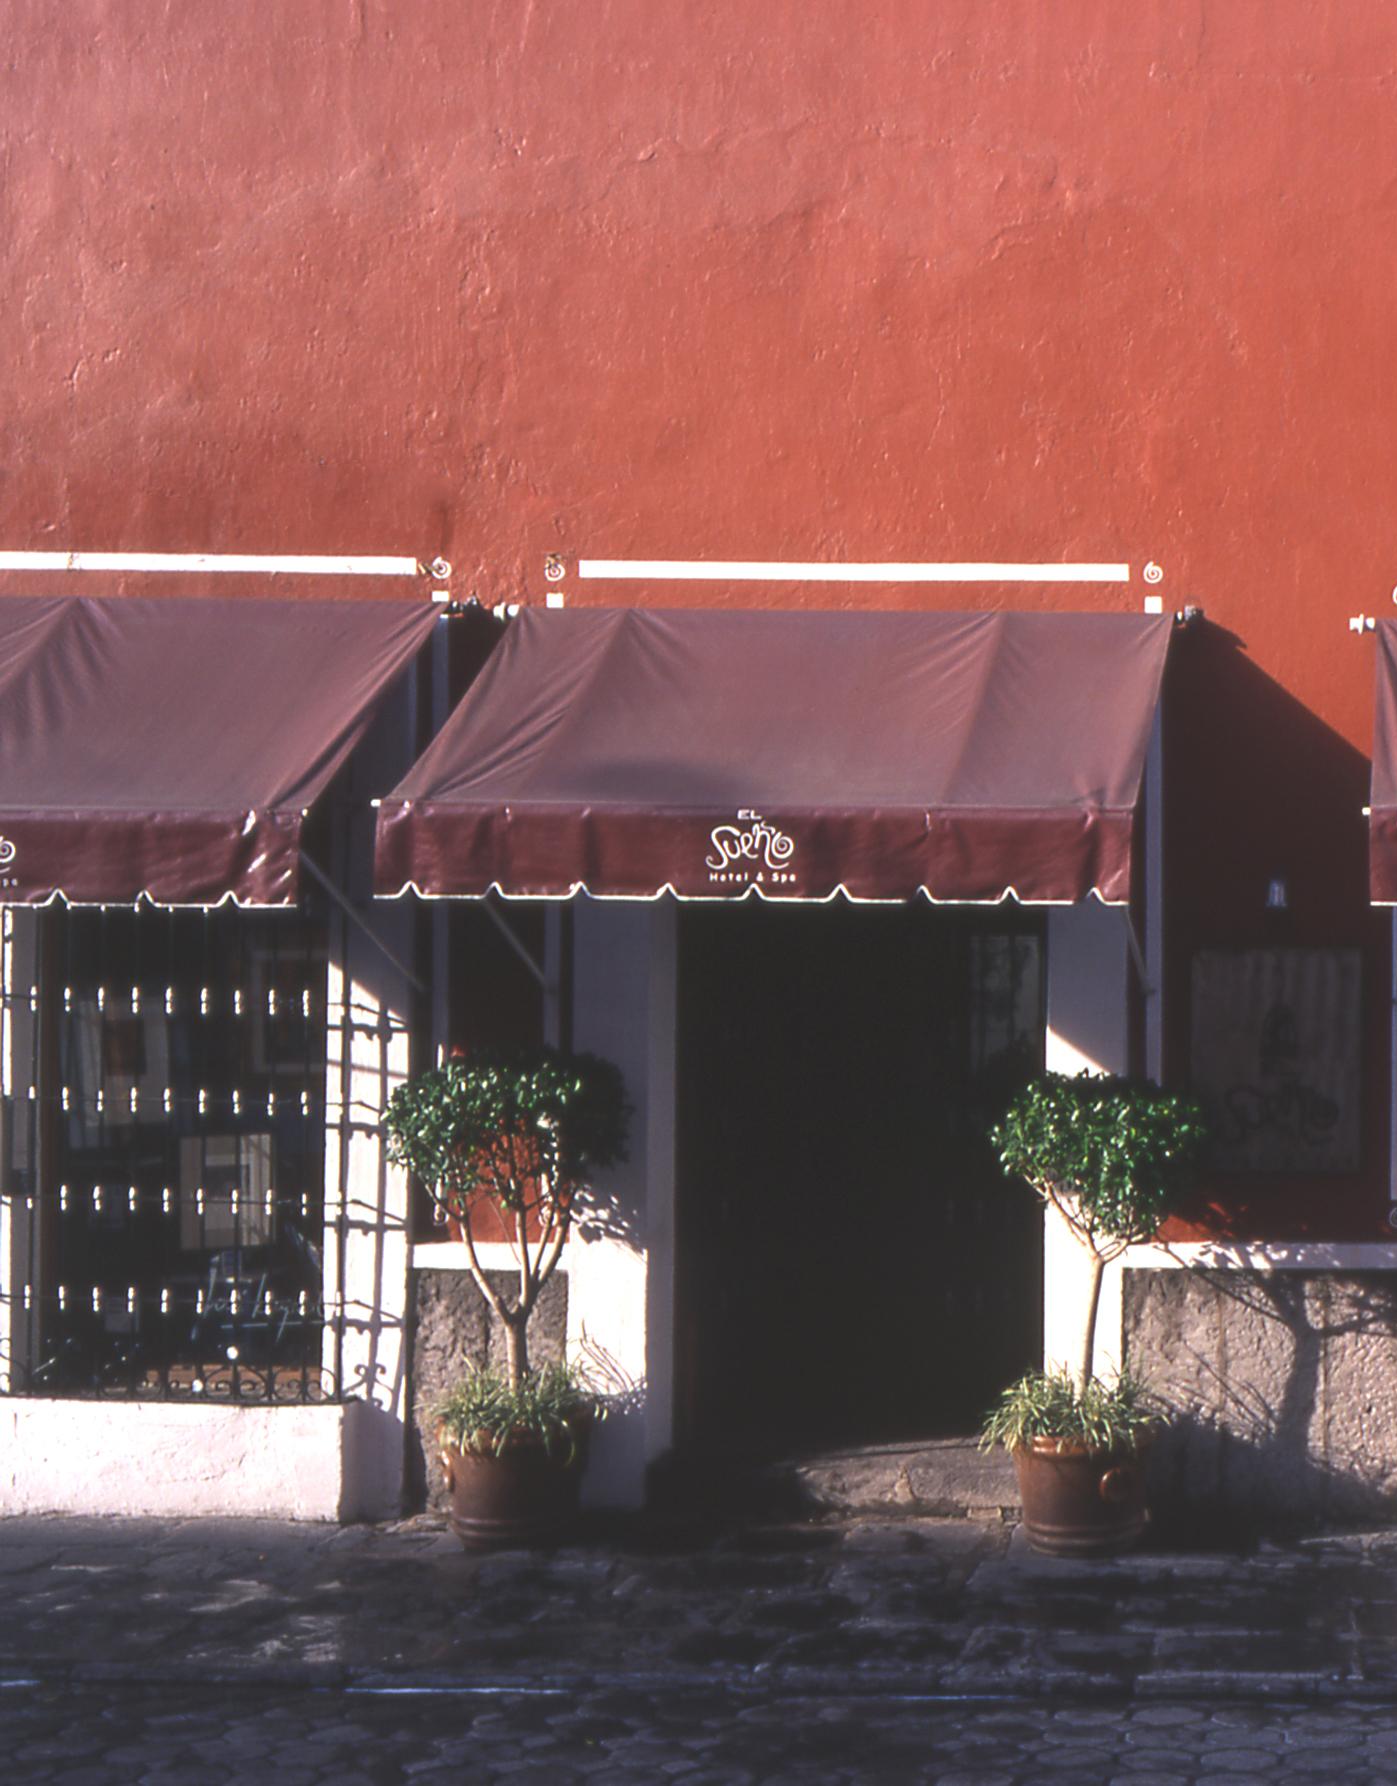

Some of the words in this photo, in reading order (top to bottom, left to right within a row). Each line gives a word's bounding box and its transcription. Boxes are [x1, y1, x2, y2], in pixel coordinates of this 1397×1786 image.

[737, 809, 762, 820] EL
[705, 821, 794, 870] Sueño
[709, 872, 749, 883] Hotel
[772, 872, 796, 884] Spa
